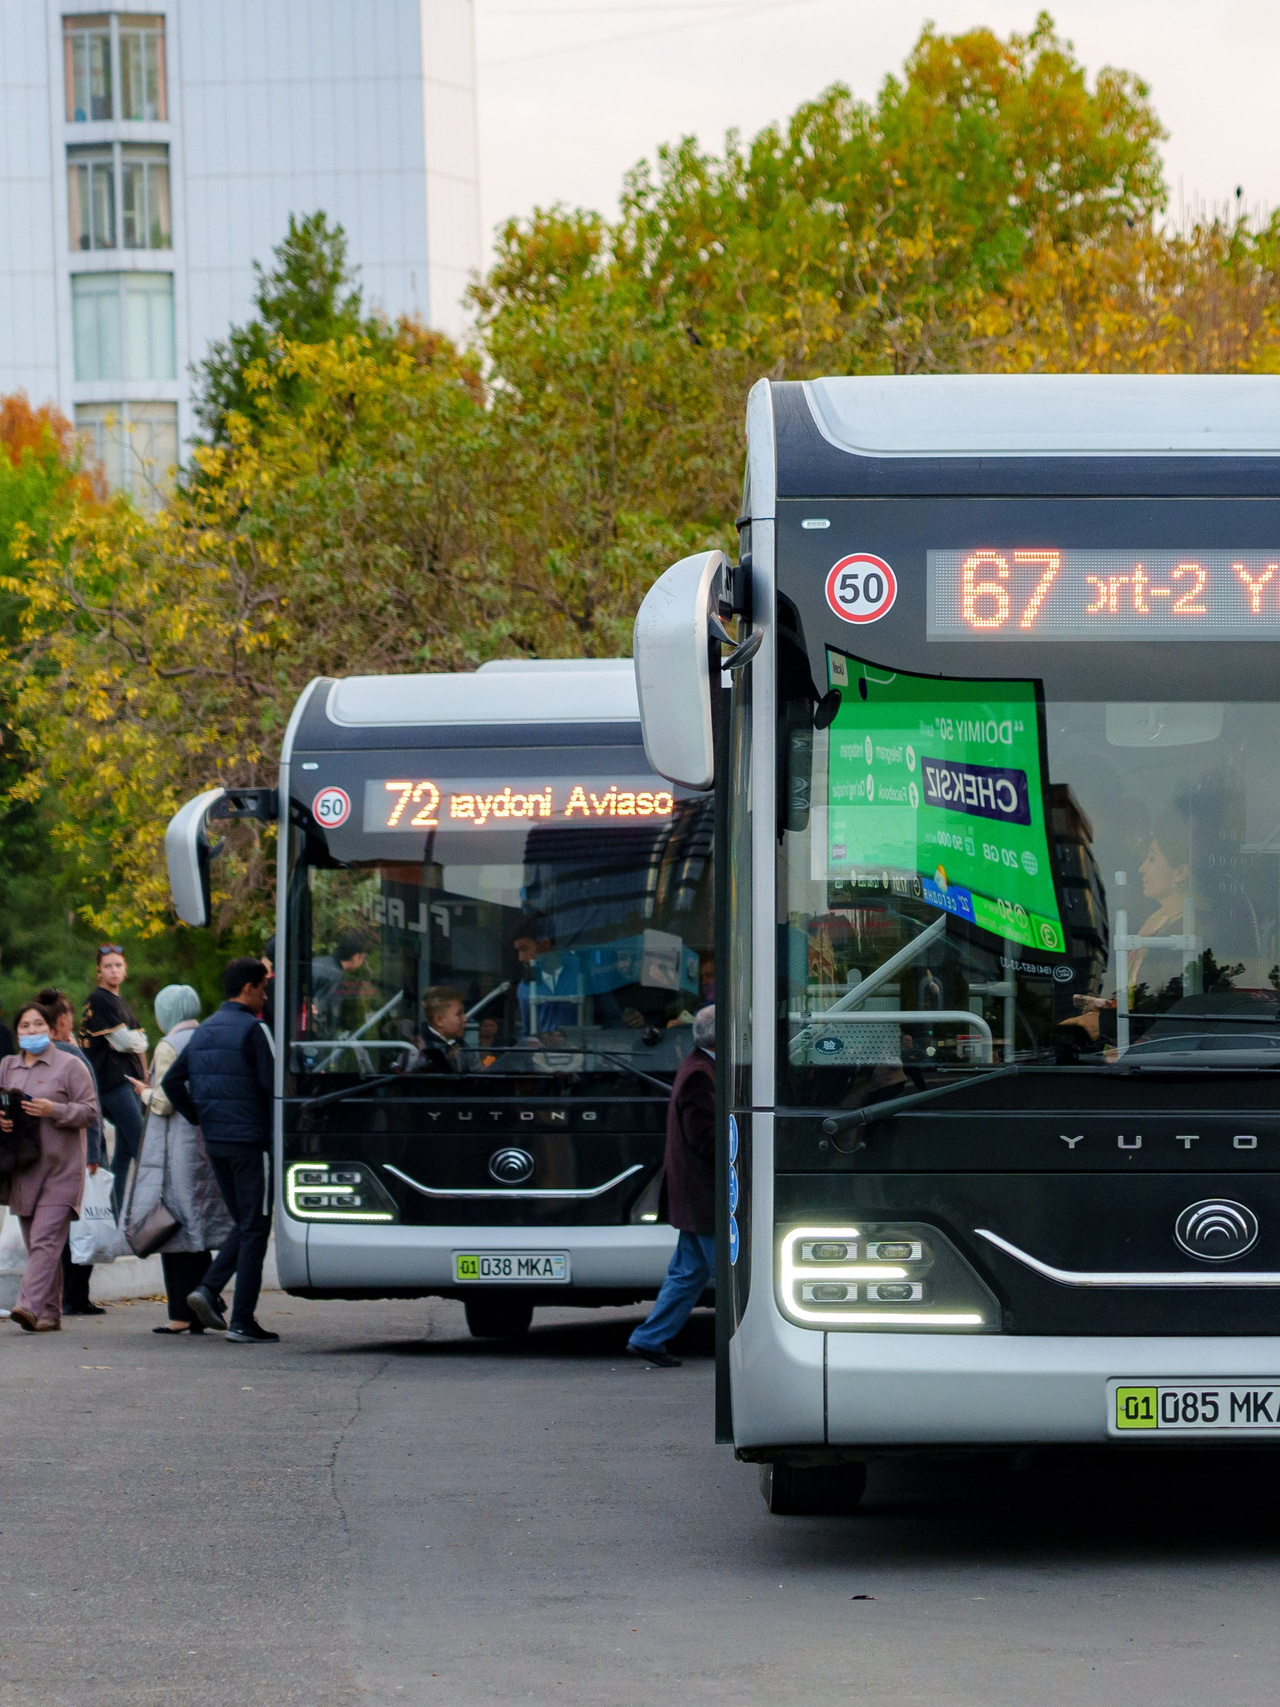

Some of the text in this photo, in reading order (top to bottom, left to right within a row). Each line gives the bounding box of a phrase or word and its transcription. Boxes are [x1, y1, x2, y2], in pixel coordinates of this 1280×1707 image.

[838, 573, 884, 604] 50
[963, 551, 1060, 628] 67
[319, 798, 343, 817] 50
[385, 782, 440, 826] 72
[565, 786, 674, 817] Aviaso
[428, 1111, 597, 1121] YUTONG
[461, 1258, 554, 1276] 01 038 MKA
[1125, 1396, 1154, 1420] 01
[1161, 1391, 1220, 1423] 085
